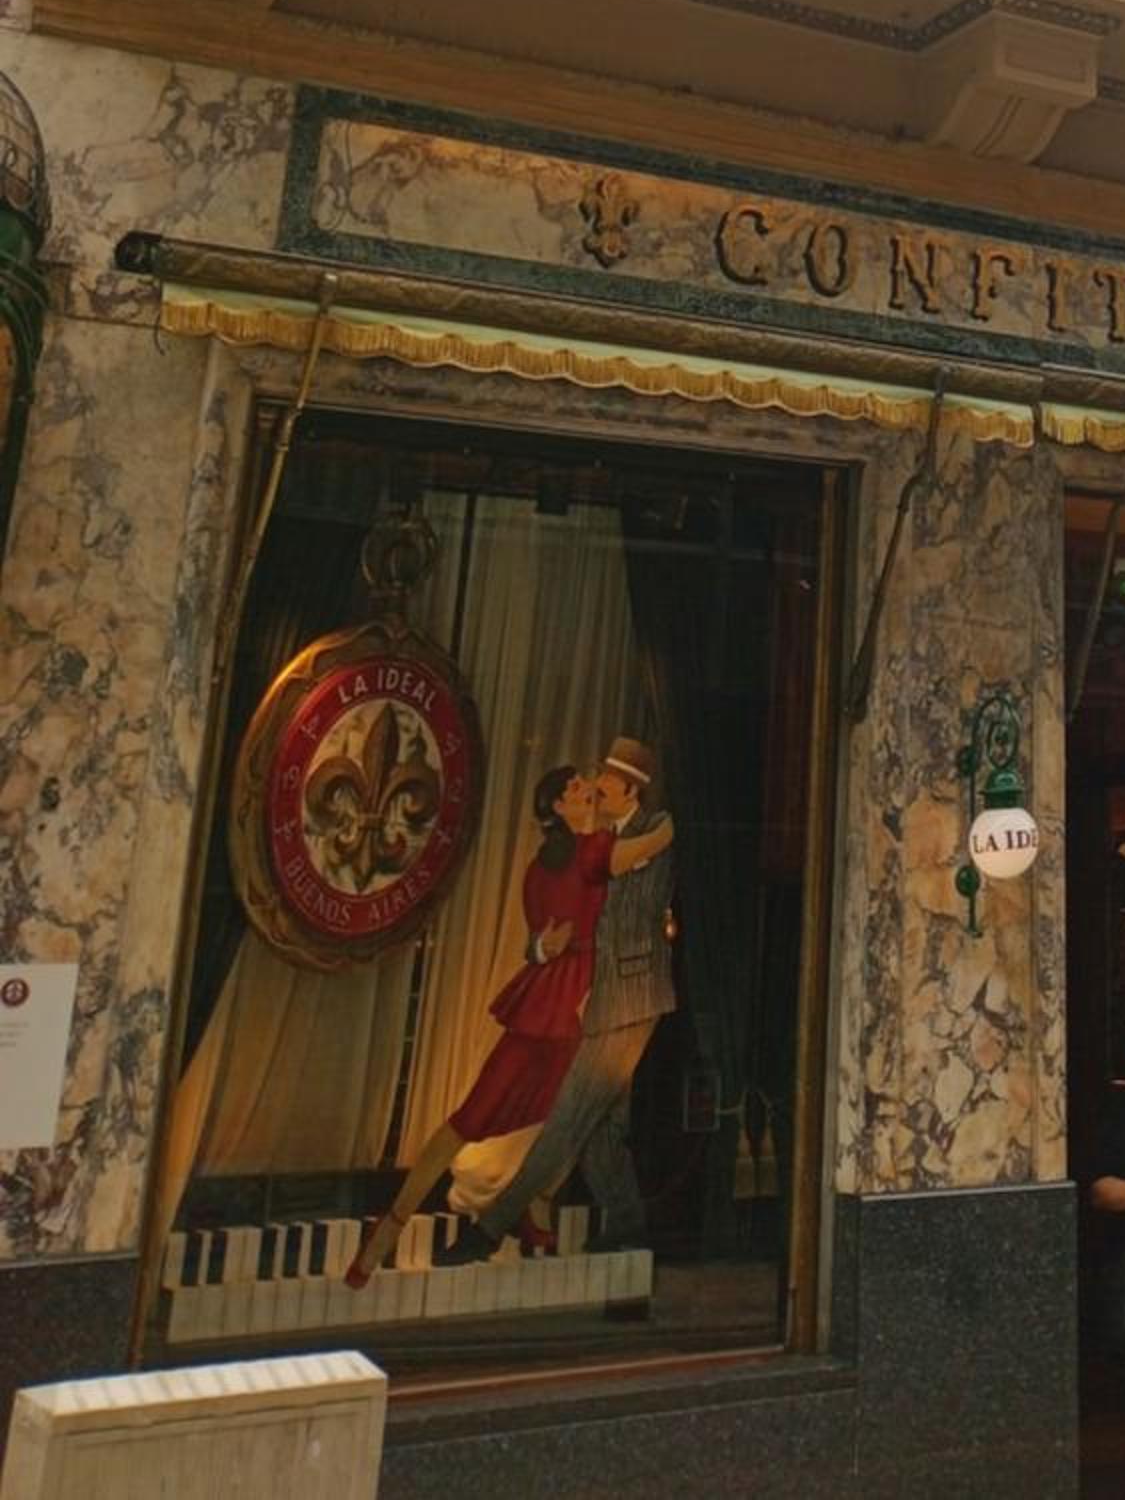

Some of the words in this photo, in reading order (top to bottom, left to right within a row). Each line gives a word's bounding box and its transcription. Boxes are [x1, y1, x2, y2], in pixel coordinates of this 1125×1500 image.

[338, 674, 368, 704] LA
[377, 667, 437, 710] IDEAL
[972, 833, 998, 853] LA
[285, 855, 354, 926] BUENOS
[367, 869, 433, 928] AIRES
